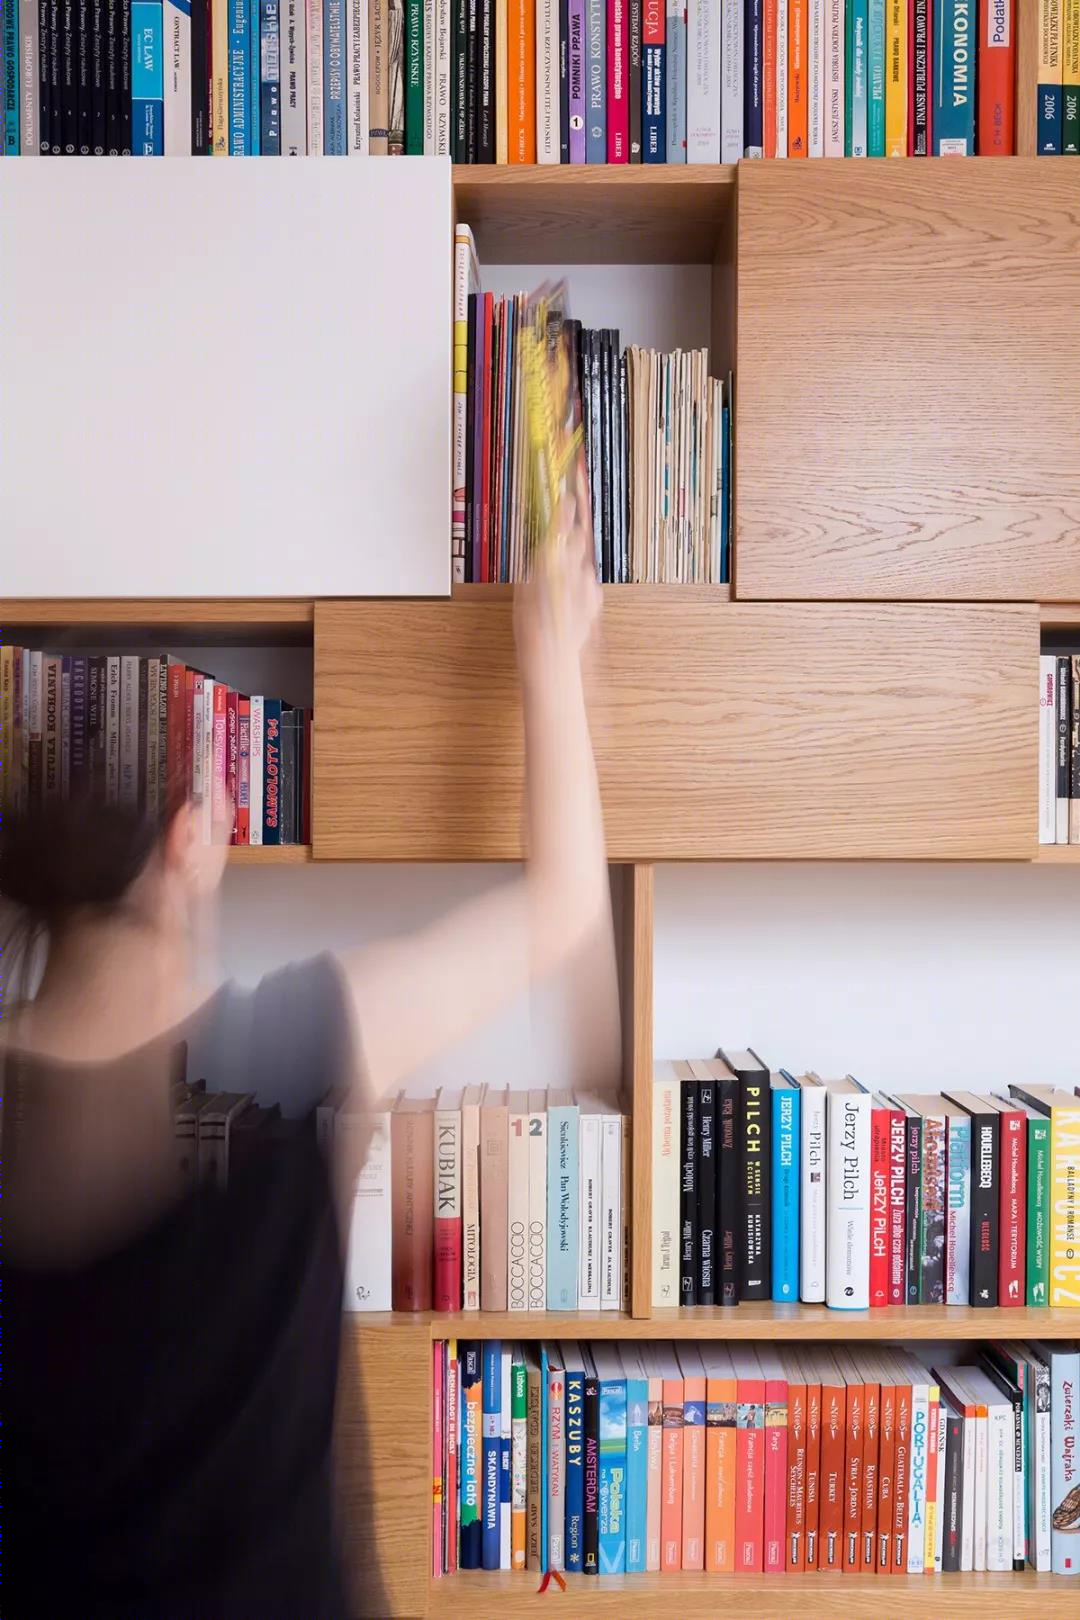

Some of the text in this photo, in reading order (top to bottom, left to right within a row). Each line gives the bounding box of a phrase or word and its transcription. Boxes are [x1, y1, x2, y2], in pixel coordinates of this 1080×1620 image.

[646, 2, 658, 35] UCJA
[6, 32, 15, 58] PRAWO
[144, 28, 153, 72] EC LAW
[438, 28, 446, 60] Bojarski
[572, 14, 580, 100] POMNIKI PRAWA
[631, 35, 639, 66] RZĄDÓW
[954, 0, 968, 107] KONOMIA
[1050, 32, 1058, 68] PŁATNIKA
[234, 50, 244, 129] ADMINISTRACYJNE
[330, 68, 340, 100] PRZEPISY
[591, 65, 602, 108] PRAWO
[917, 15, 926, 126] FINANSE PUBLICZNE PRAWO
[25, 91, 33, 146] DOKUMENTY
[1045, 94, 1055, 120] 2006
[1067, 95, 1076, 120] 2006
[47, 664, 56, 732] KOCHANIA
[214, 718, 225, 772] Toksyczne
[240, 722, 250, 750] Factfile
[266, 718, 278, 828] SAMOLOTY '94
[511, 1119, 522, 1136] 1
[529, 1119, 542, 1136] 2
[701, 1116, 712, 1158] Henry Miller
[722, 1098, 732, 1149] Zwrotnik Raka
[746, 1087, 760, 1152] PILCH
[780, 1096, 792, 1166] JERZY PILCH
[840, 1102, 860, 1150] Jerzy
[438, 1125, 456, 1211] KUBIAK
[810, 1132, 820, 1166] Pilch
[910, 1126, 920, 1174] jerzy pilch
[950, 1126, 970, 1208] Platform
[980, 1126, 992, 1188] HOUELLEBECQ
[1010, 1138, 1018, 1157] Michel
[558, 1120, 569, 1252] Sienkiewicz Pan Wołodyjowski
[683, 1162, 694, 1192] Moloch
[844, 1156, 860, 1200] Pilch
[892, 1118, 904, 1254] JERZY PILCH albo czas
[1010, 1158, 1018, 1194] Houellebecq
[1036, 1150, 1044, 1269] Michel Houellebecq WYSPY
[1067, 1166, 1075, 1241] BALLADYNY ROMANSE
[467, 1224, 476, 1282] MITOLOGIA
[660, 1230, 670, 1270] Tarun Tejpal
[684, 1220, 694, 1260] Henry Miller
[702, 1230, 712, 1287] Czarna wiosna
[724, 1230, 734, 1270] Henry Miller
[511, 1222, 524, 1309] BOCCACCIO
[530, 1221, 544, 1308] BOCCACCIO
[948, 1240, 956, 1292] Houellebecq
[516, 1371, 525, 1398] Lizbona
[552, 1407, 560, 1440] RZYM
[633, 1430, 641, 1451] Berlin
[718, 1432, 726, 1458] Francja
[747, 1432, 756, 1459] Francja
[771, 1432, 780, 1450] Paryż
[1062, 1380, 1076, 1482] Zwierzaki Wajraka
[464, 1402, 478, 1506] bezpieczne lato
[569, 1380, 581, 1548] KASZUBY Region
[586, 1438, 596, 1512] AMSTERDAM
[601, 1469, 606, 1478] na
[488, 1450, 496, 1528] SKANDYNAWIA
[610, 1468, 623, 1534] Polska
[808, 1472, 816, 1503] TUNISIA
[829, 1472, 837, 1503] TURKEY
[848, 1456, 858, 1518] SYRIA JORDAN
[866, 1465, 875, 1509] RAJASTHAN
[882, 1476, 890, 1499] CUBA
[896, 1446, 904, 1528] GUATEMALA BELIZE
[552, 1536, 561, 1562] Pascal
